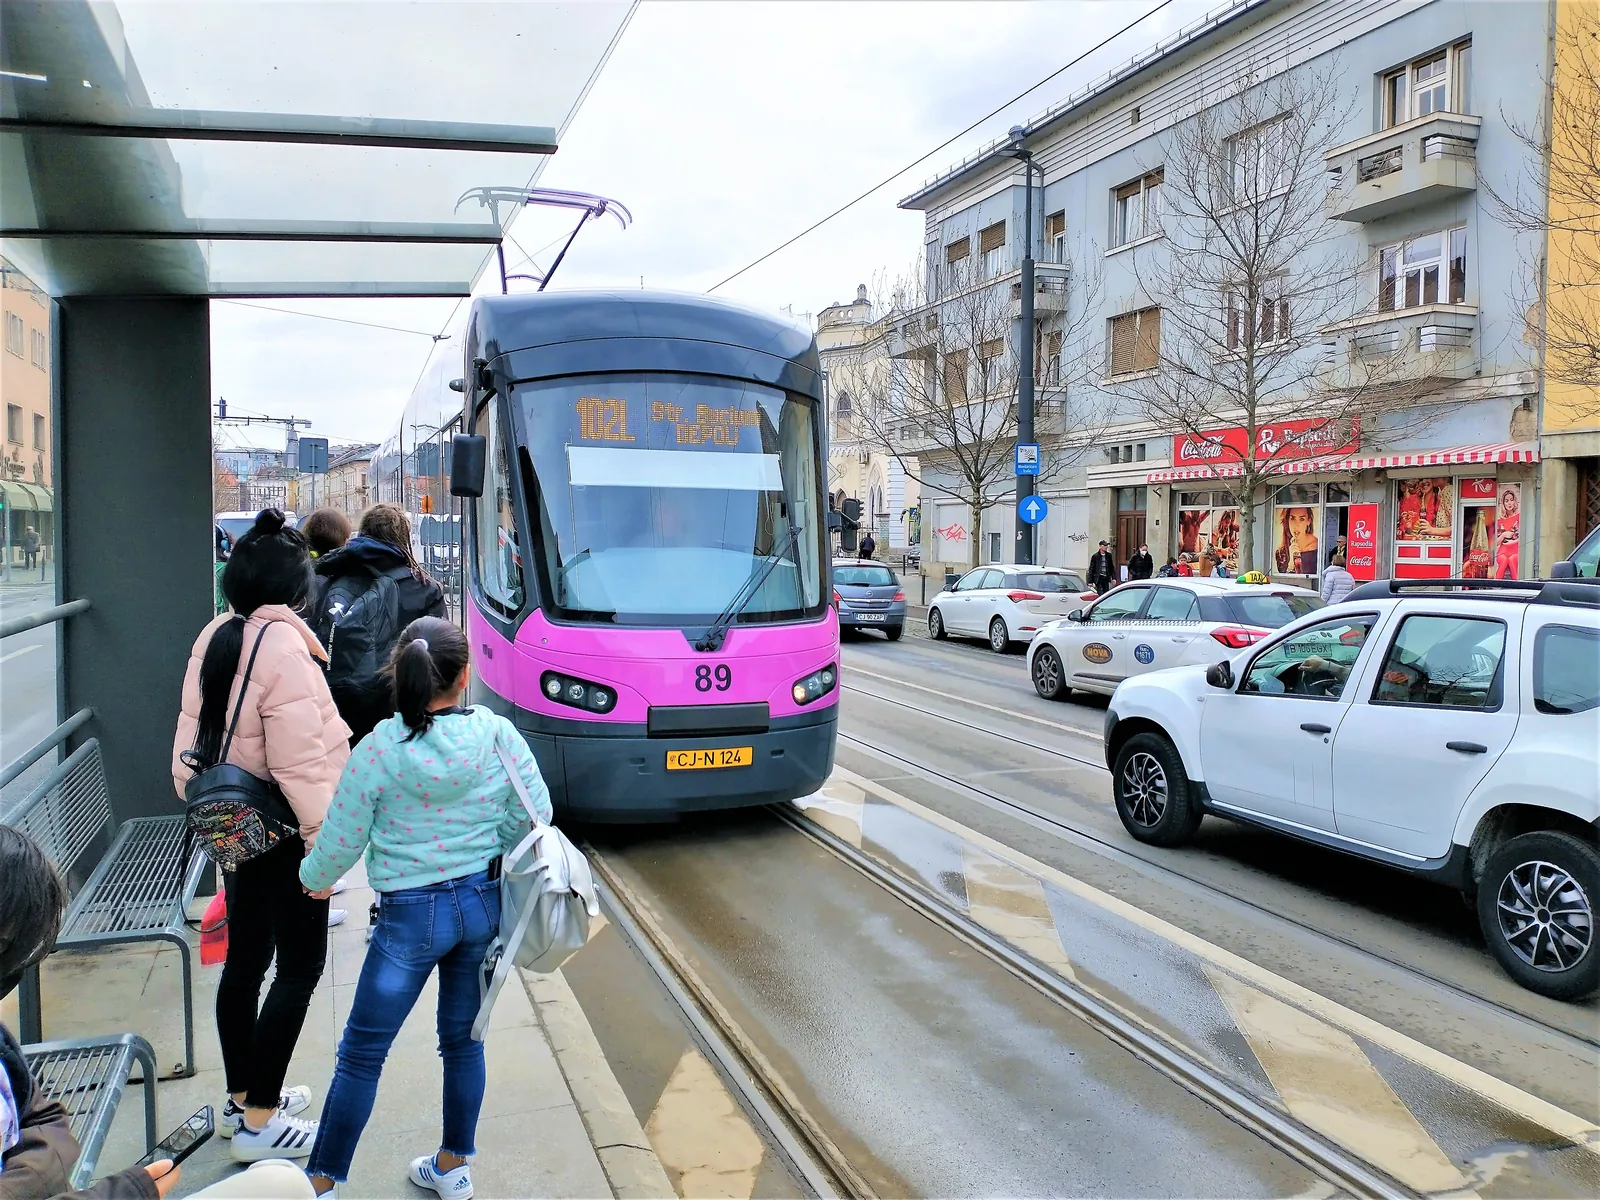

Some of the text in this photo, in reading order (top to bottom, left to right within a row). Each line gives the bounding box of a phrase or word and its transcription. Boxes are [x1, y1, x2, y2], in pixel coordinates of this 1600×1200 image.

[575, 396, 636, 441] 102L
[651, 401, 761, 426] Str. Bucium
[676, 423, 739, 446] DEPOU
[1351, 540, 1373, 549] Rapsodia
[1087, 648, 1109, 658] NOVA
[695, 664, 732, 692] 89
[677, 750, 741, 767] CJ-N 124
